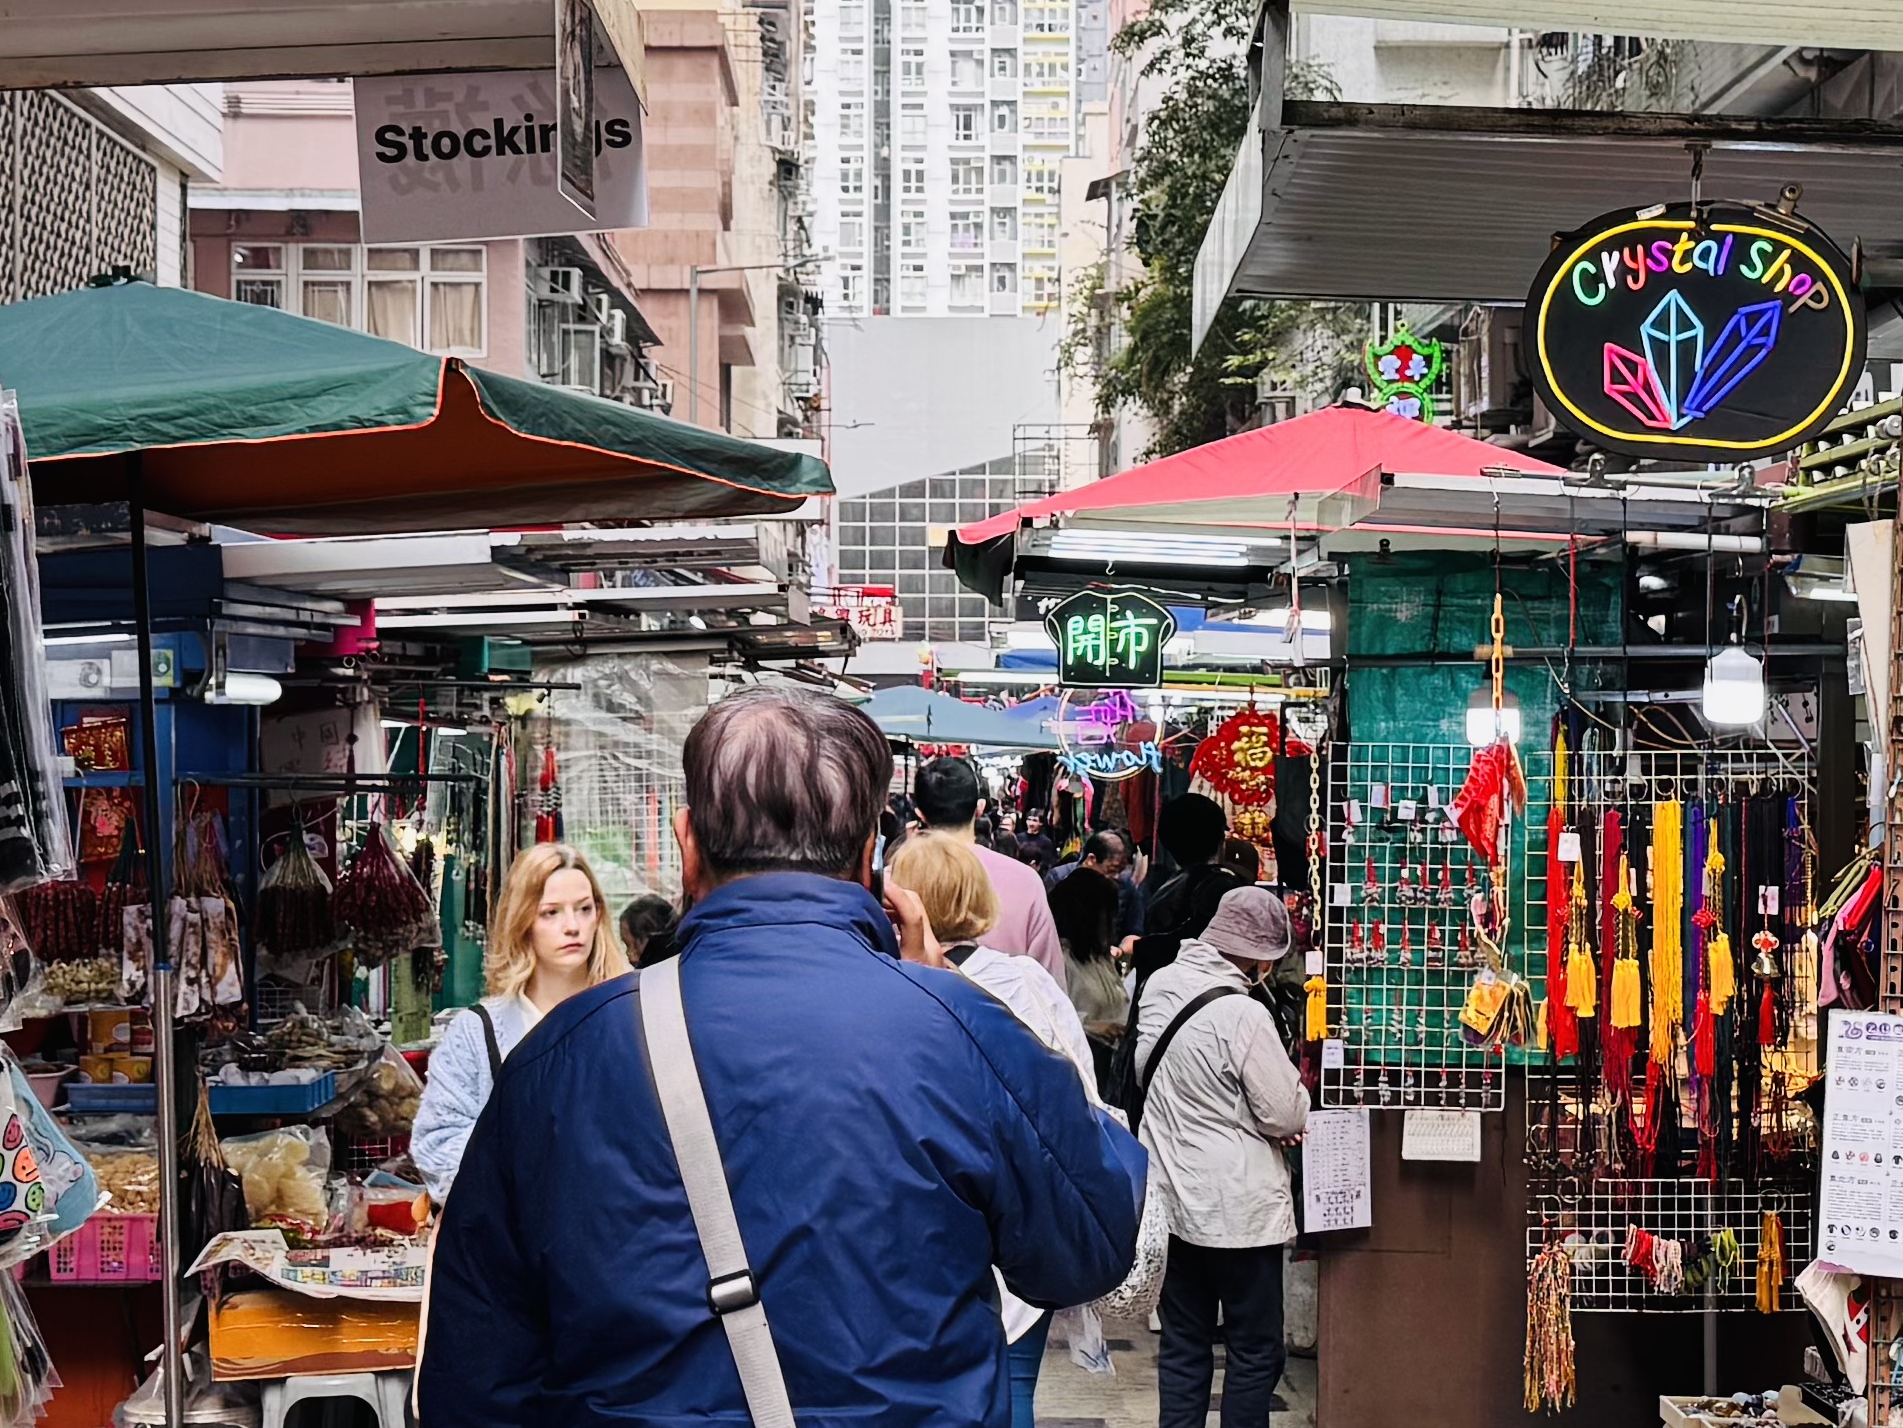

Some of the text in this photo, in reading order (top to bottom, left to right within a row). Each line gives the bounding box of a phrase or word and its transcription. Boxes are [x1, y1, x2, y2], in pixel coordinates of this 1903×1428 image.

[1576, 232, 1831, 315] Crystal Shop
[1066, 609, 1159, 671] 開市
